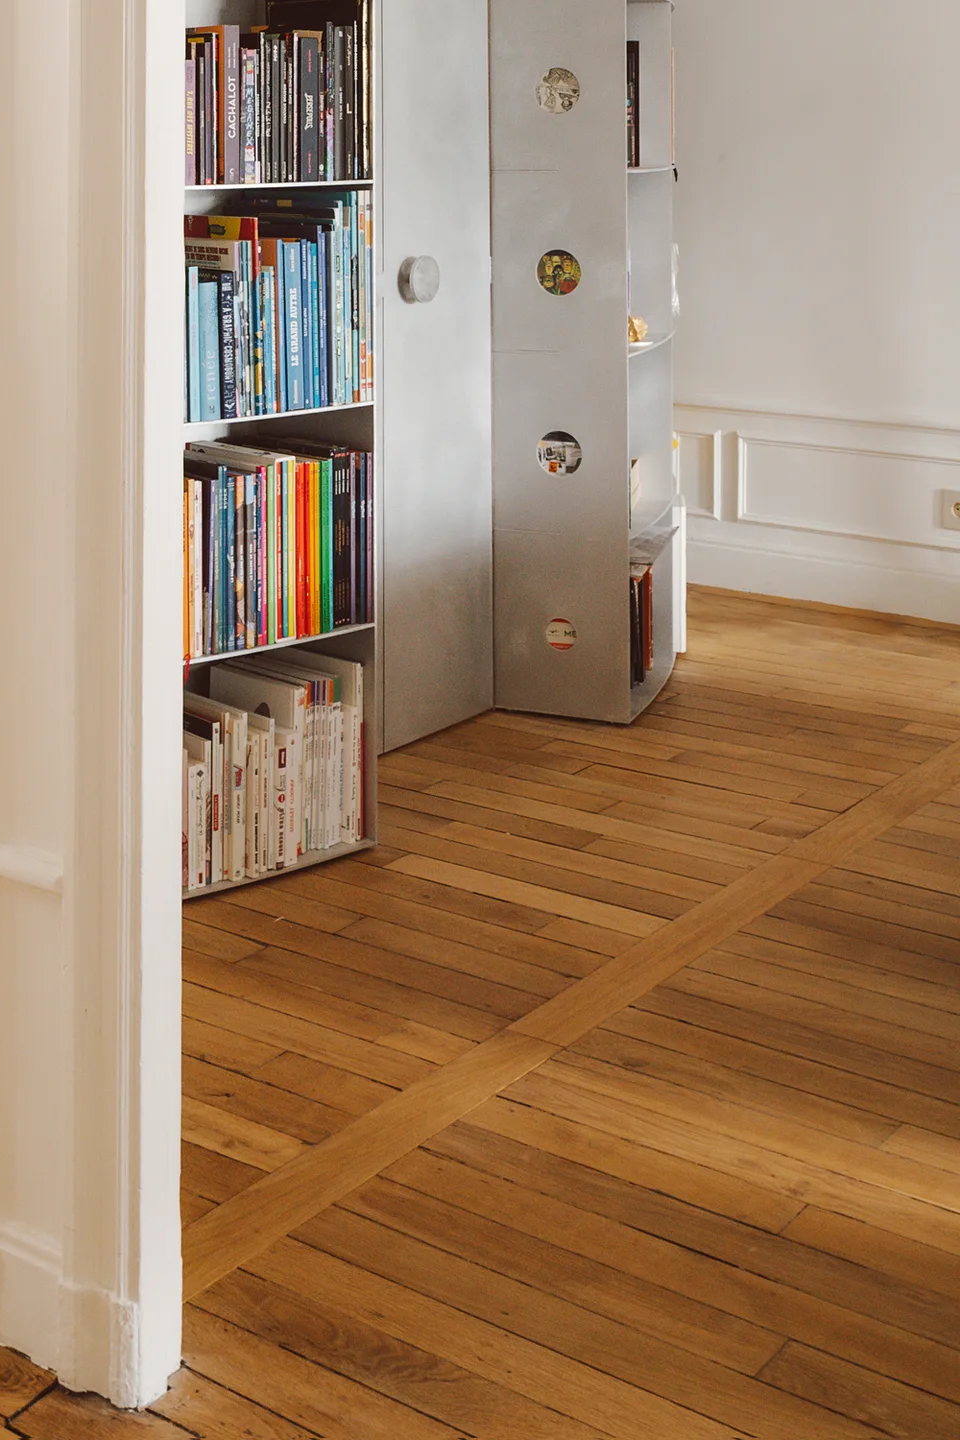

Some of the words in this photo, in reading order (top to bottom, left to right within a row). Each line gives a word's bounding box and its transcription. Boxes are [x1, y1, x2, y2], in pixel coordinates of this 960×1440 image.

[228, 76, 236, 139] CACHALOT
[246, 88, 255, 147] MEGAHEX
[305, 93, 315, 131] PERSEPOLIS
[289, 288, 298, 322] AUTRE
[290, 324, 298, 356] GRAND
[203, 351, 217, 401] renée
[290, 358, 298, 367] LE
